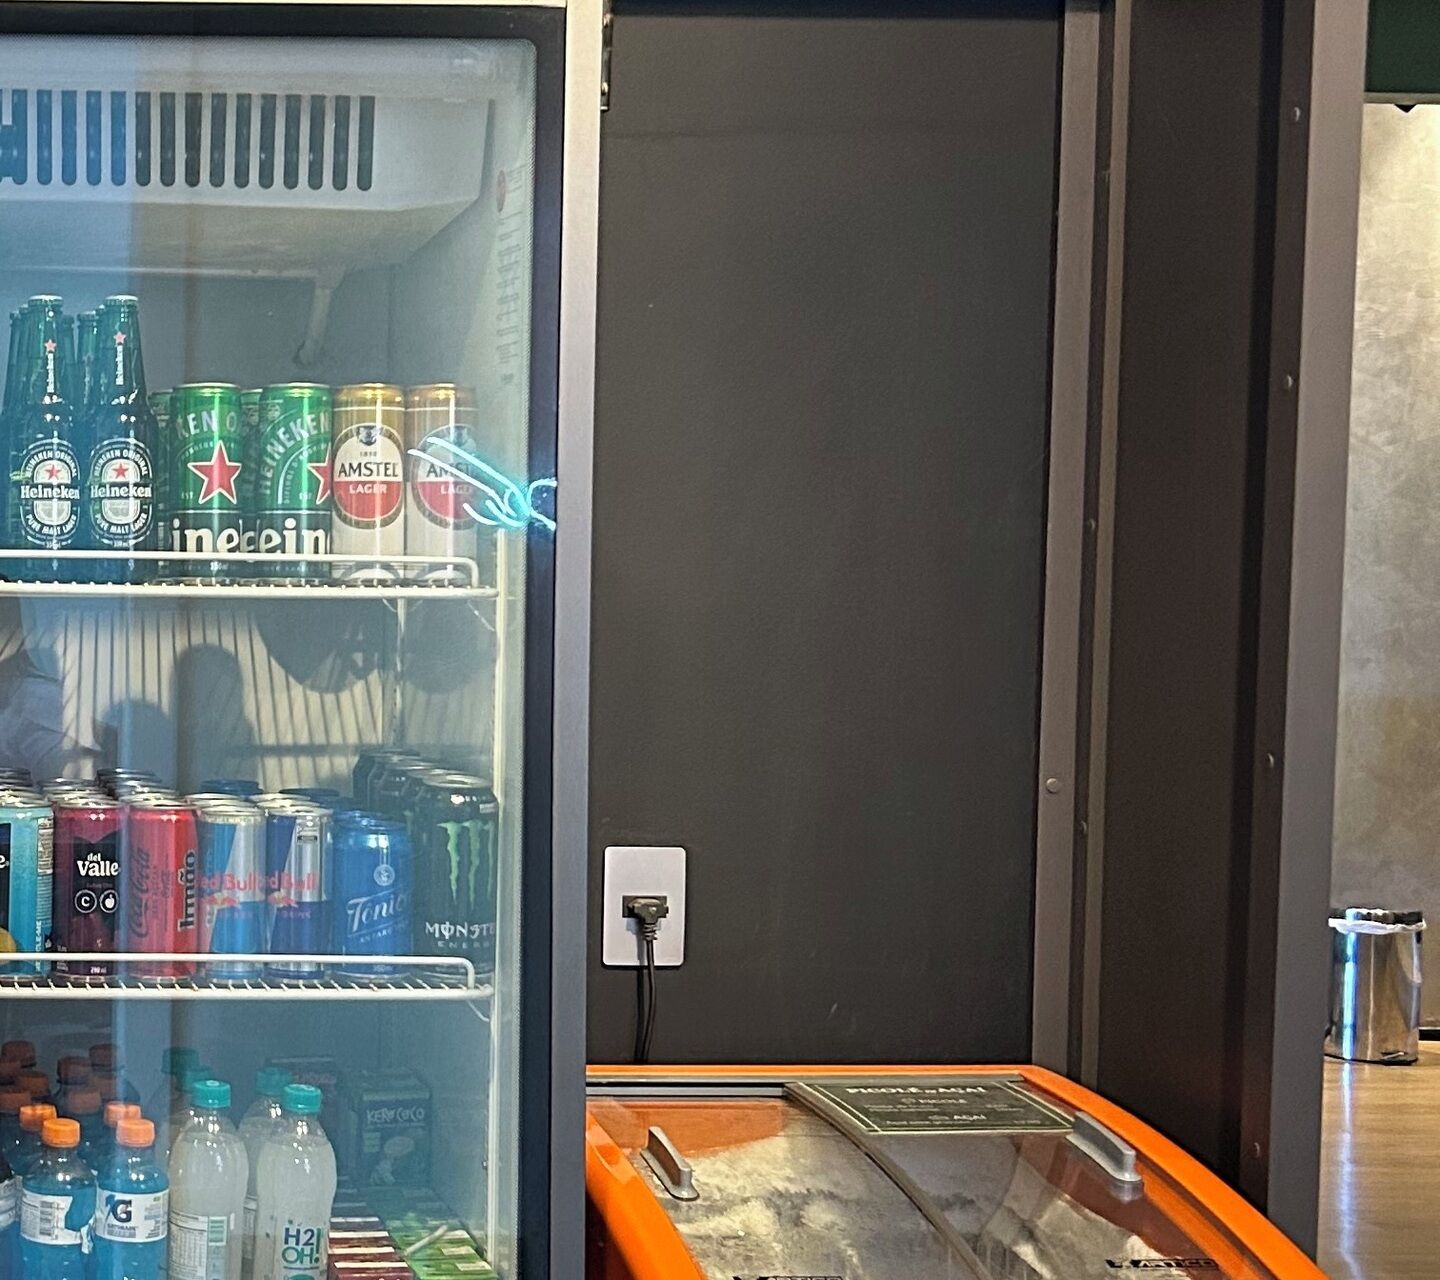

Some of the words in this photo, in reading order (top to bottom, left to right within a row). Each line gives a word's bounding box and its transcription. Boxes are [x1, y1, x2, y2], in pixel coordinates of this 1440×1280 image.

[337, 461, 399, 478] AMSTEL
[20, 484, 80, 500] Heineken
[90, 484, 153, 499] Heineken
[349, 483, 388, 494] LAGER
[87, 852, 102, 862] del
[76, 860, 120, 877] Valle
[424, 920, 496, 940] MONSTE
[112, 1199, 132, 1222] G
[283, 1227, 315, 1246] H2
